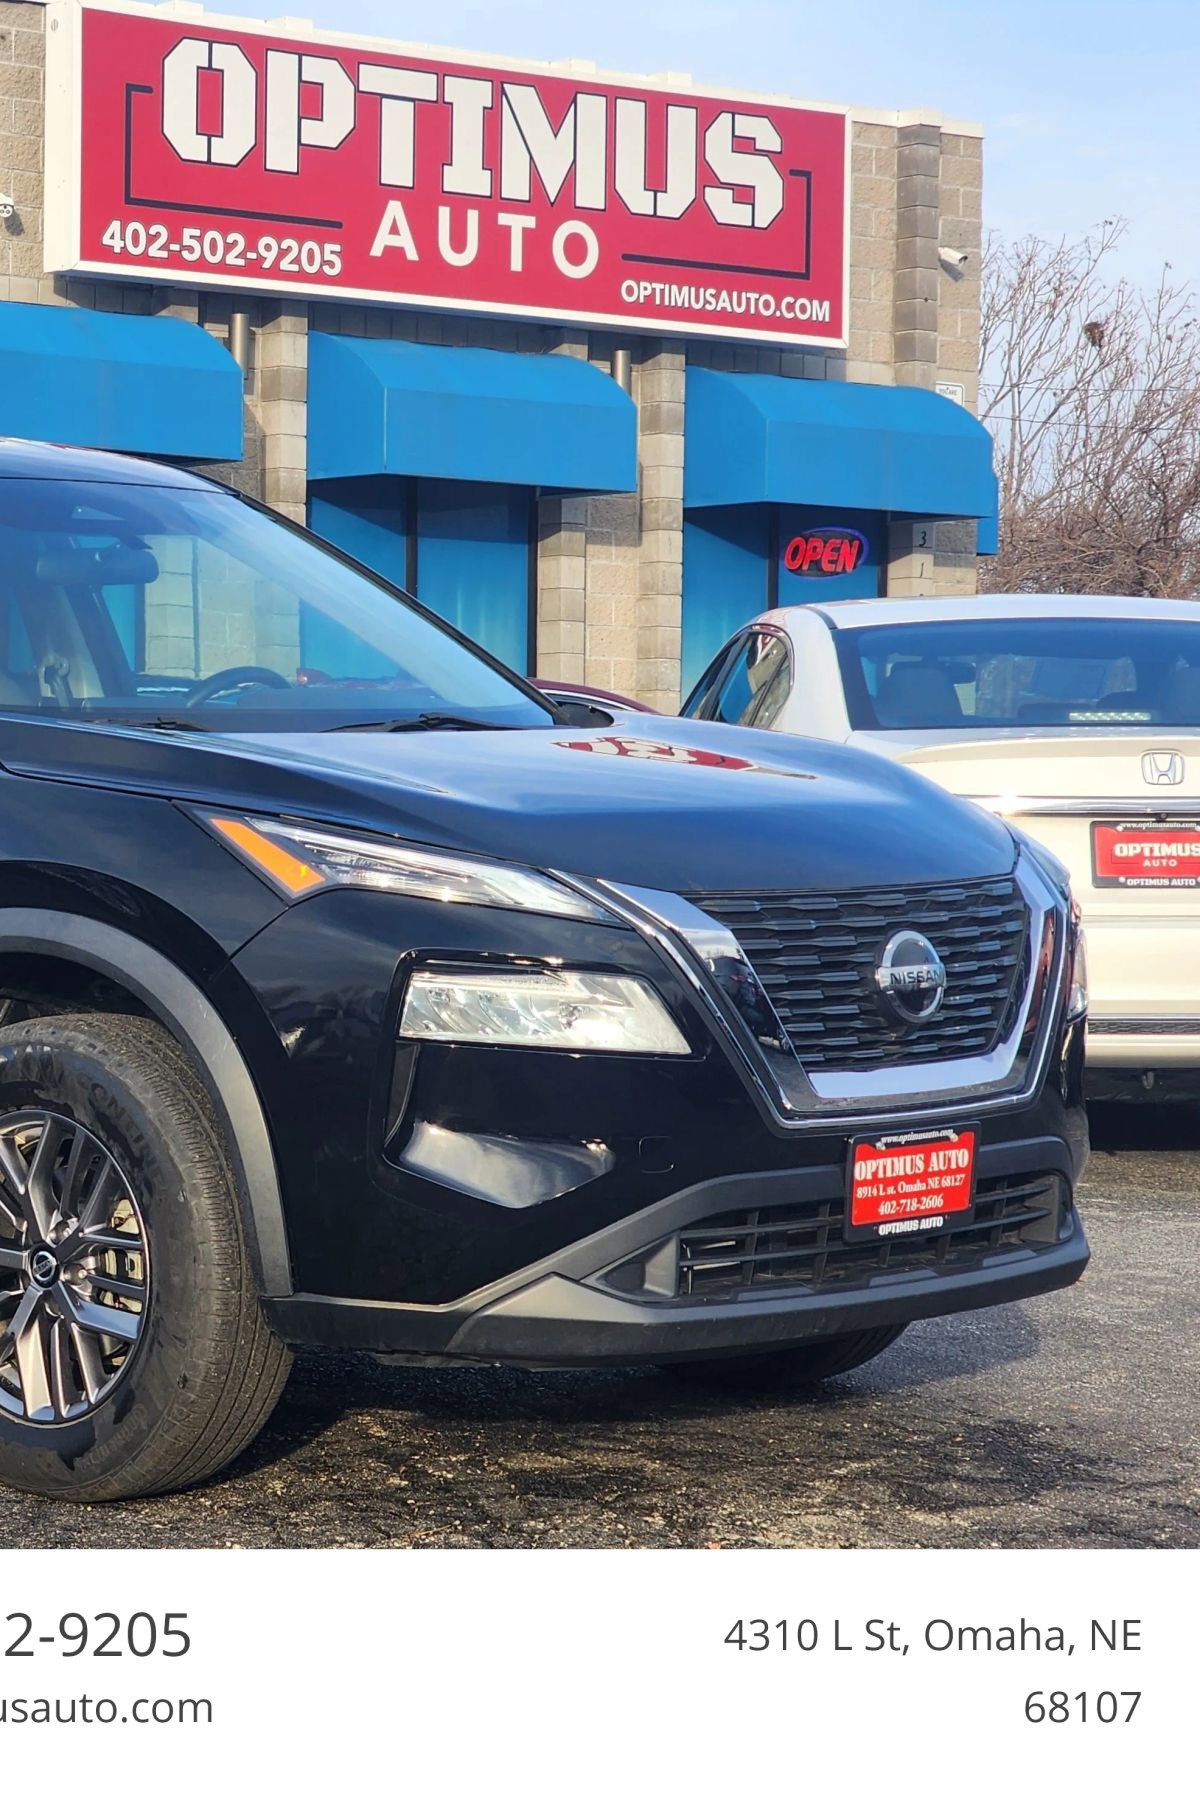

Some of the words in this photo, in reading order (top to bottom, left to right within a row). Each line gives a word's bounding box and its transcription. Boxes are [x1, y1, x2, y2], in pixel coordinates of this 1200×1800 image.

[161, 37, 785, 229] OPTIMUS
[101, 220, 343, 277] 402-502-9205
[369, 199, 600, 279] AUTO
[620, 279, 831, 323] OPTIMUSAUTO.COM
[784, 536, 860, 573] OPEN
[1114, 843, 1200, 857] OPTIMUS
[1143, 859, 1178, 868] AUTO
[1126, 878, 1169, 887] OPTIMUS
[1170, 878, 1196, 887] AUTO
[890, 969, 941, 986] NISSAN
[855, 1153, 925, 1181] OPTIMUS
[928, 1148, 970, 1172] AUTO
[856, 1184, 878, 1199] 8914
[878, 1184, 886, 1196] L
[897, 1179, 926, 1193] Omaha
[927, 1177, 941, 1190] NE
[941, 1174, 966, 1187] 68127
[878, 1194, 944, 1216] 402-718-2606
[878, 1218, 919, 1236] OPTIMUS
[920, 1216, 944, 1229] AUTO
